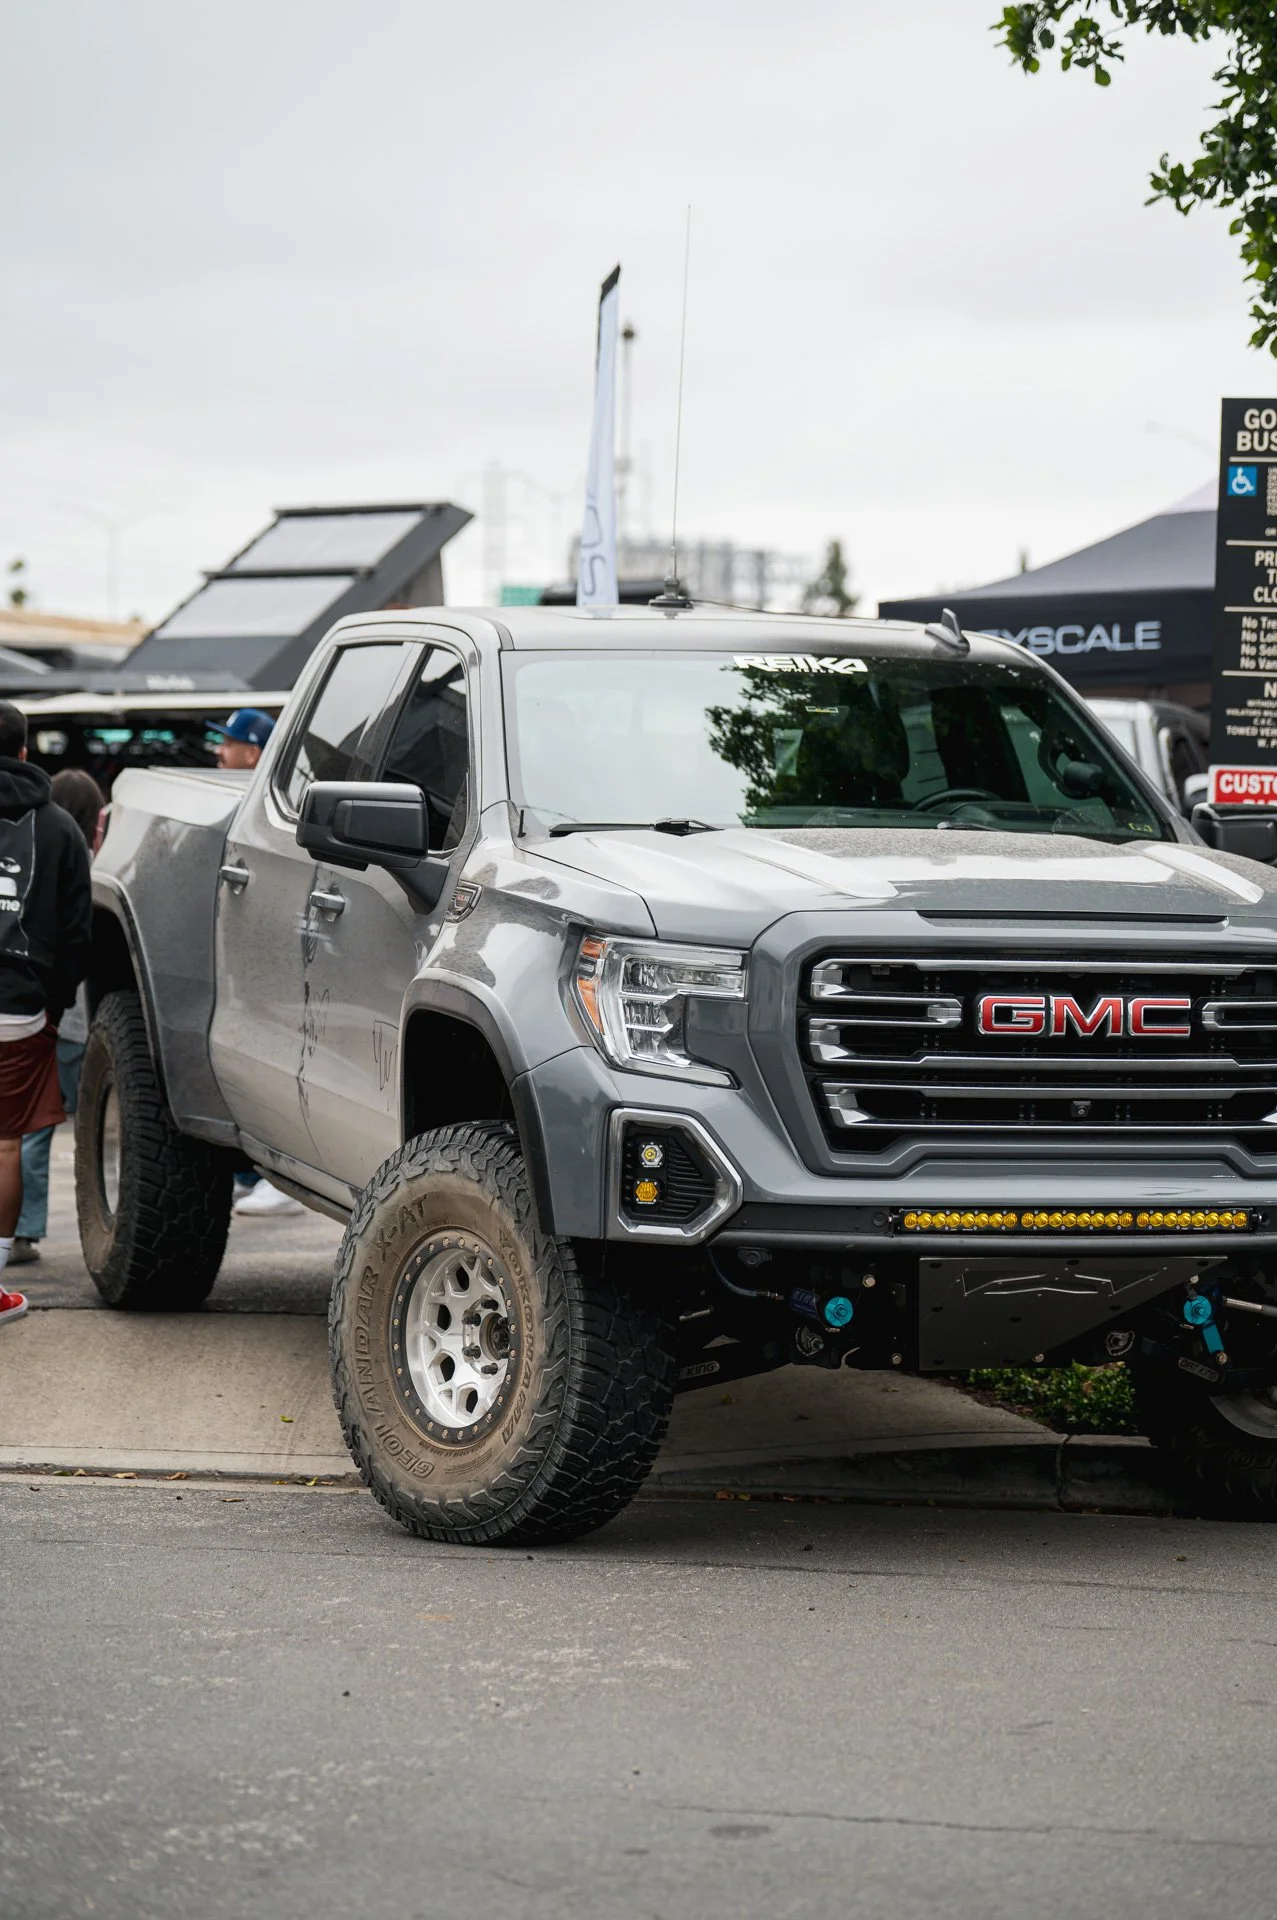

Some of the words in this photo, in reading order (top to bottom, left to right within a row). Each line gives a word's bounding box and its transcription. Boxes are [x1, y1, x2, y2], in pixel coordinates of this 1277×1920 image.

[1241, 615, 1258, 629] No
[1241, 629, 1258, 643] No
[1240, 642, 1257, 656] No
[732, 654, 869, 675] REIKA
[1240, 656, 1257, 670] No
[978, 994, 1192, 1038] GMC
